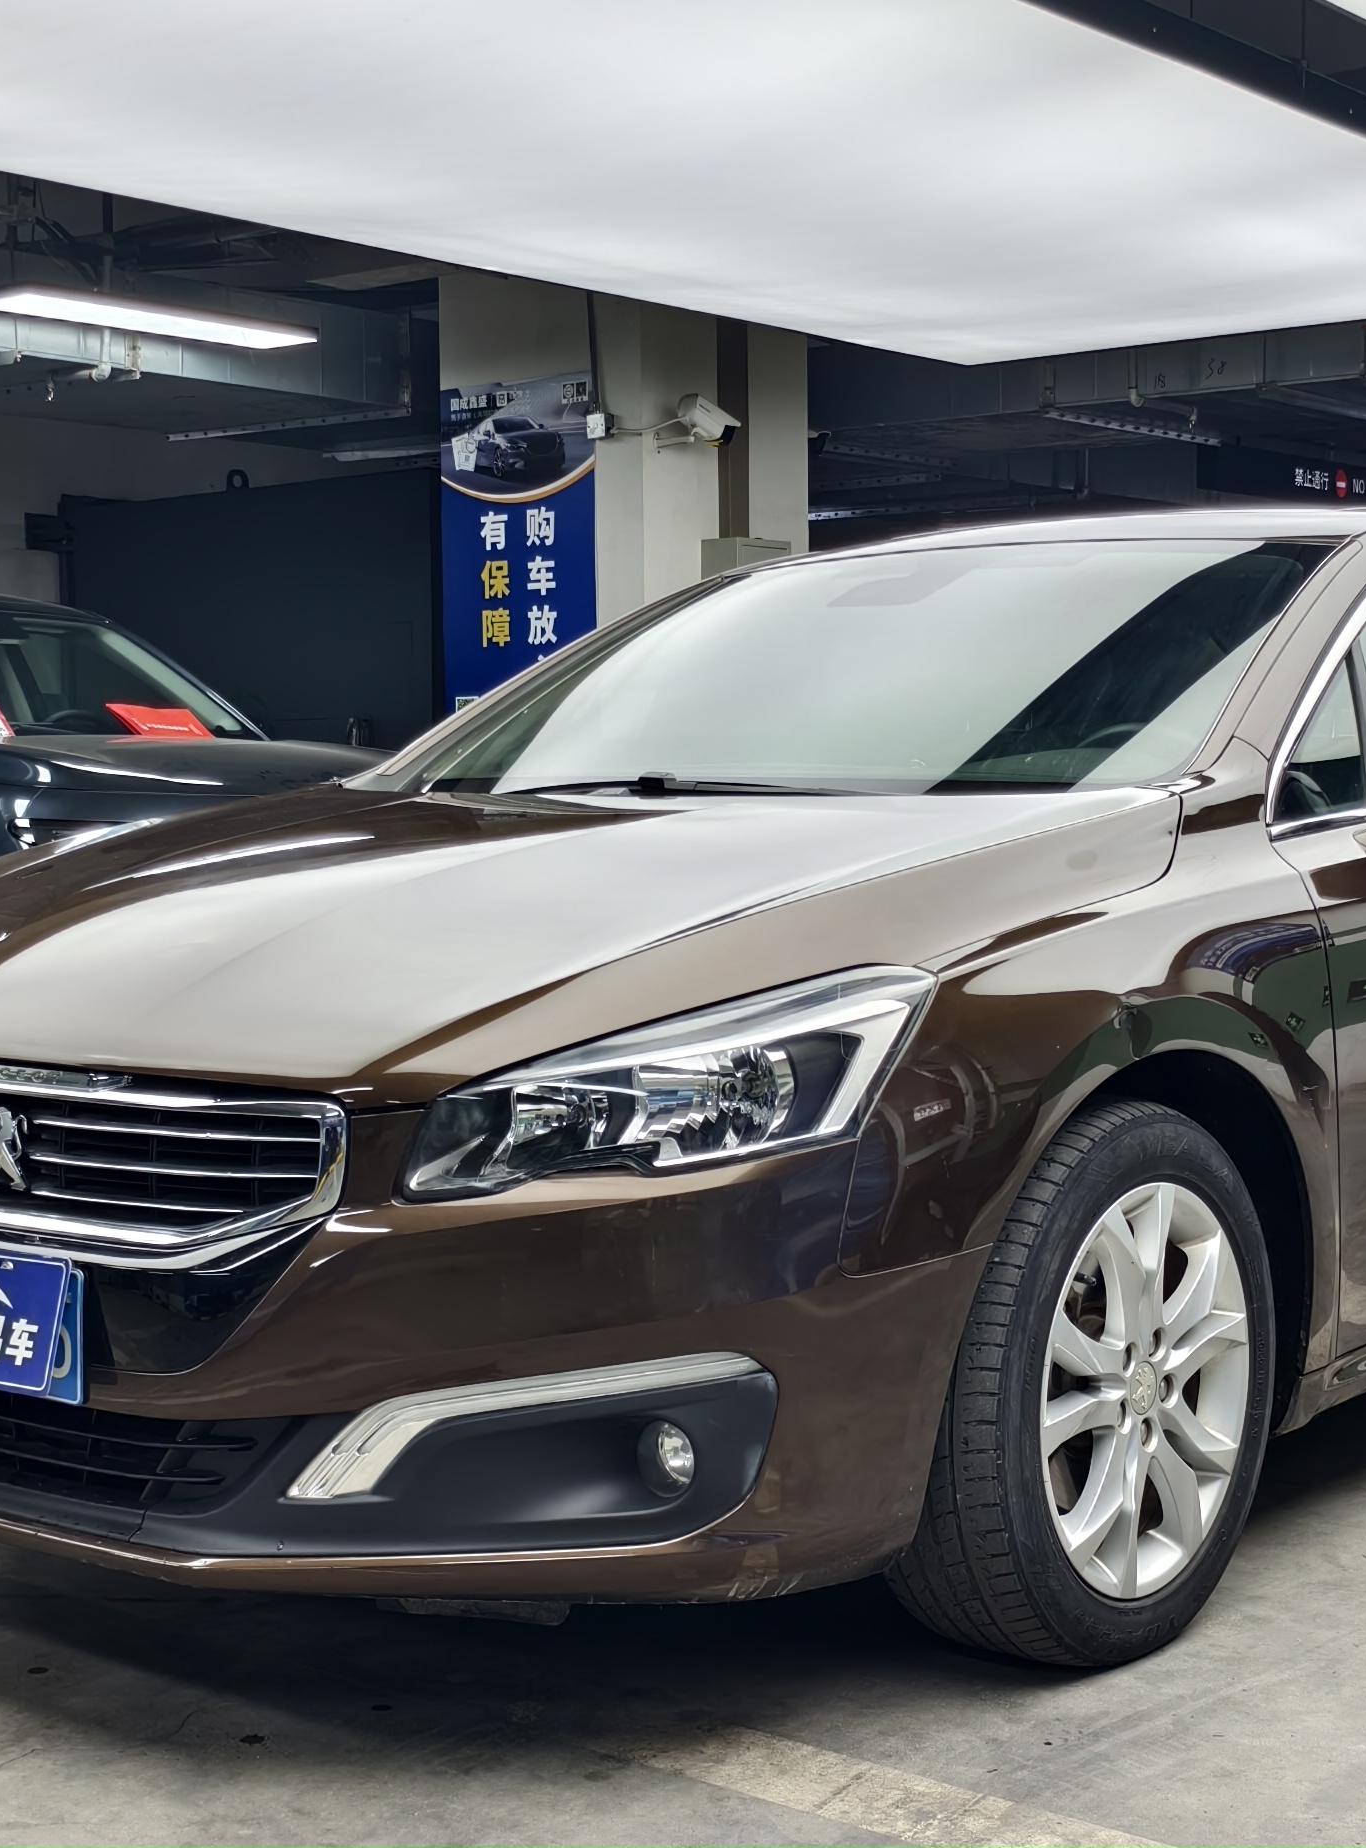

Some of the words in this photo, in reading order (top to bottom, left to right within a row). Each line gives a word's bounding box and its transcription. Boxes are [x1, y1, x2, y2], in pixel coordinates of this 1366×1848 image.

[1294, 468, 1329, 491] 禁止通行
[1352, 479, 1365, 495] NO
[480, 511, 511, 648] 有保障
[525, 506, 558, 662] 购车放
